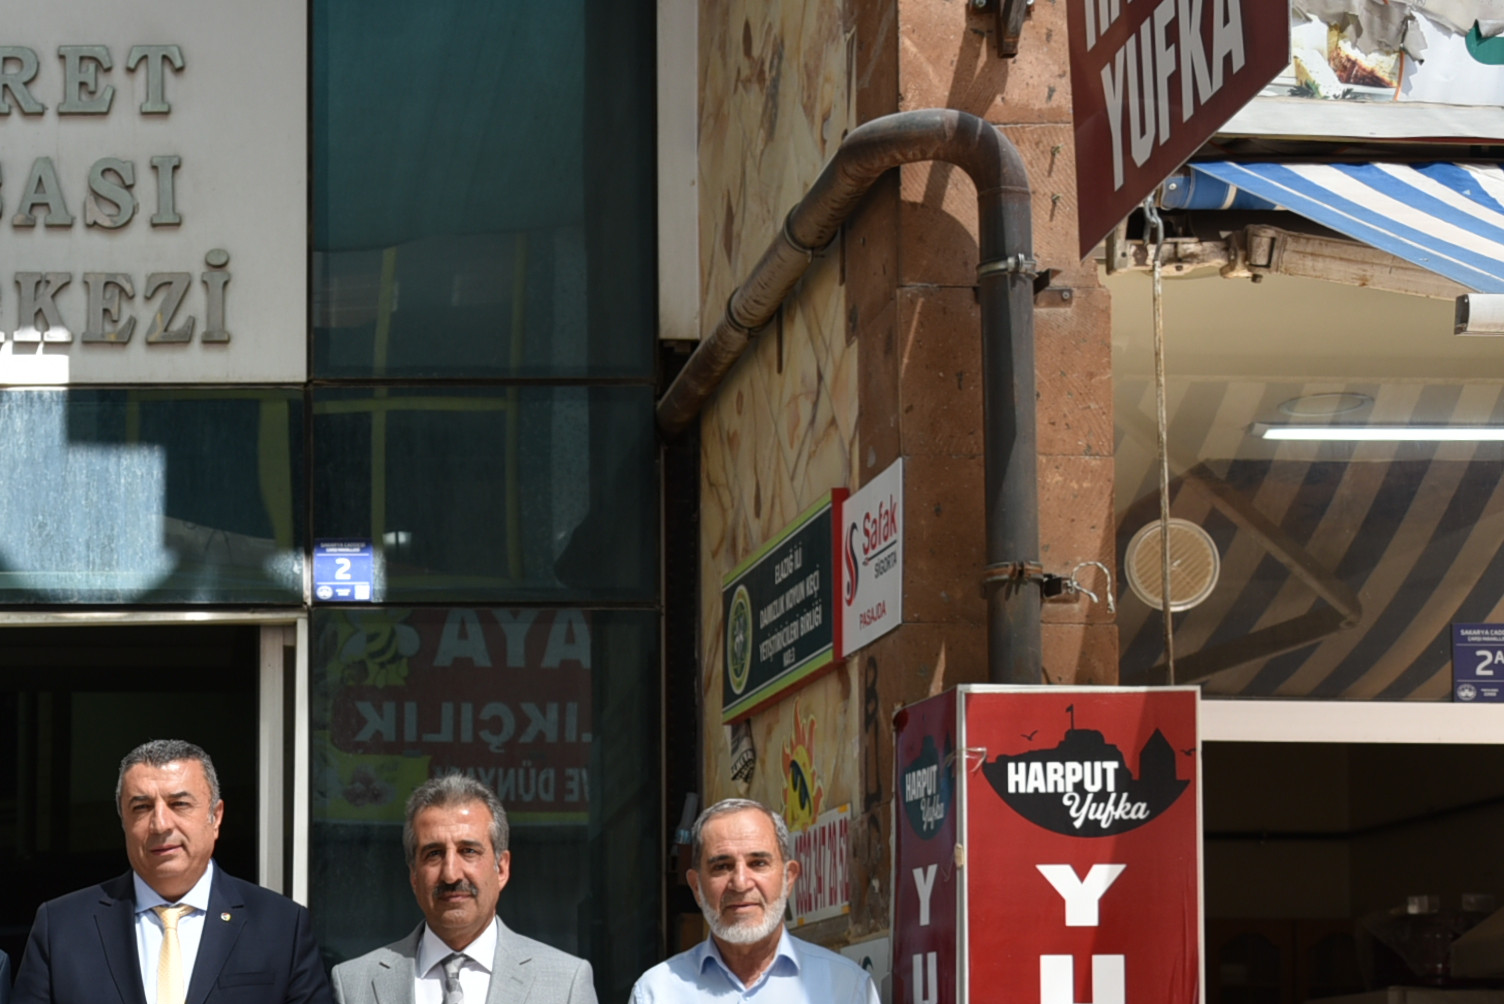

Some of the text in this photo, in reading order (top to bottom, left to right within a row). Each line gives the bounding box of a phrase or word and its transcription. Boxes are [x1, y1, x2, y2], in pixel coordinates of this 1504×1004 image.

[1100, 0, 1245, 192] YUFKA
[335, 557, 352, 580] 2
[905, 765, 938, 802] HARPUT
[1007, 761, 1119, 793] HARPUT
[1062, 791, 1150, 829] Yufka
